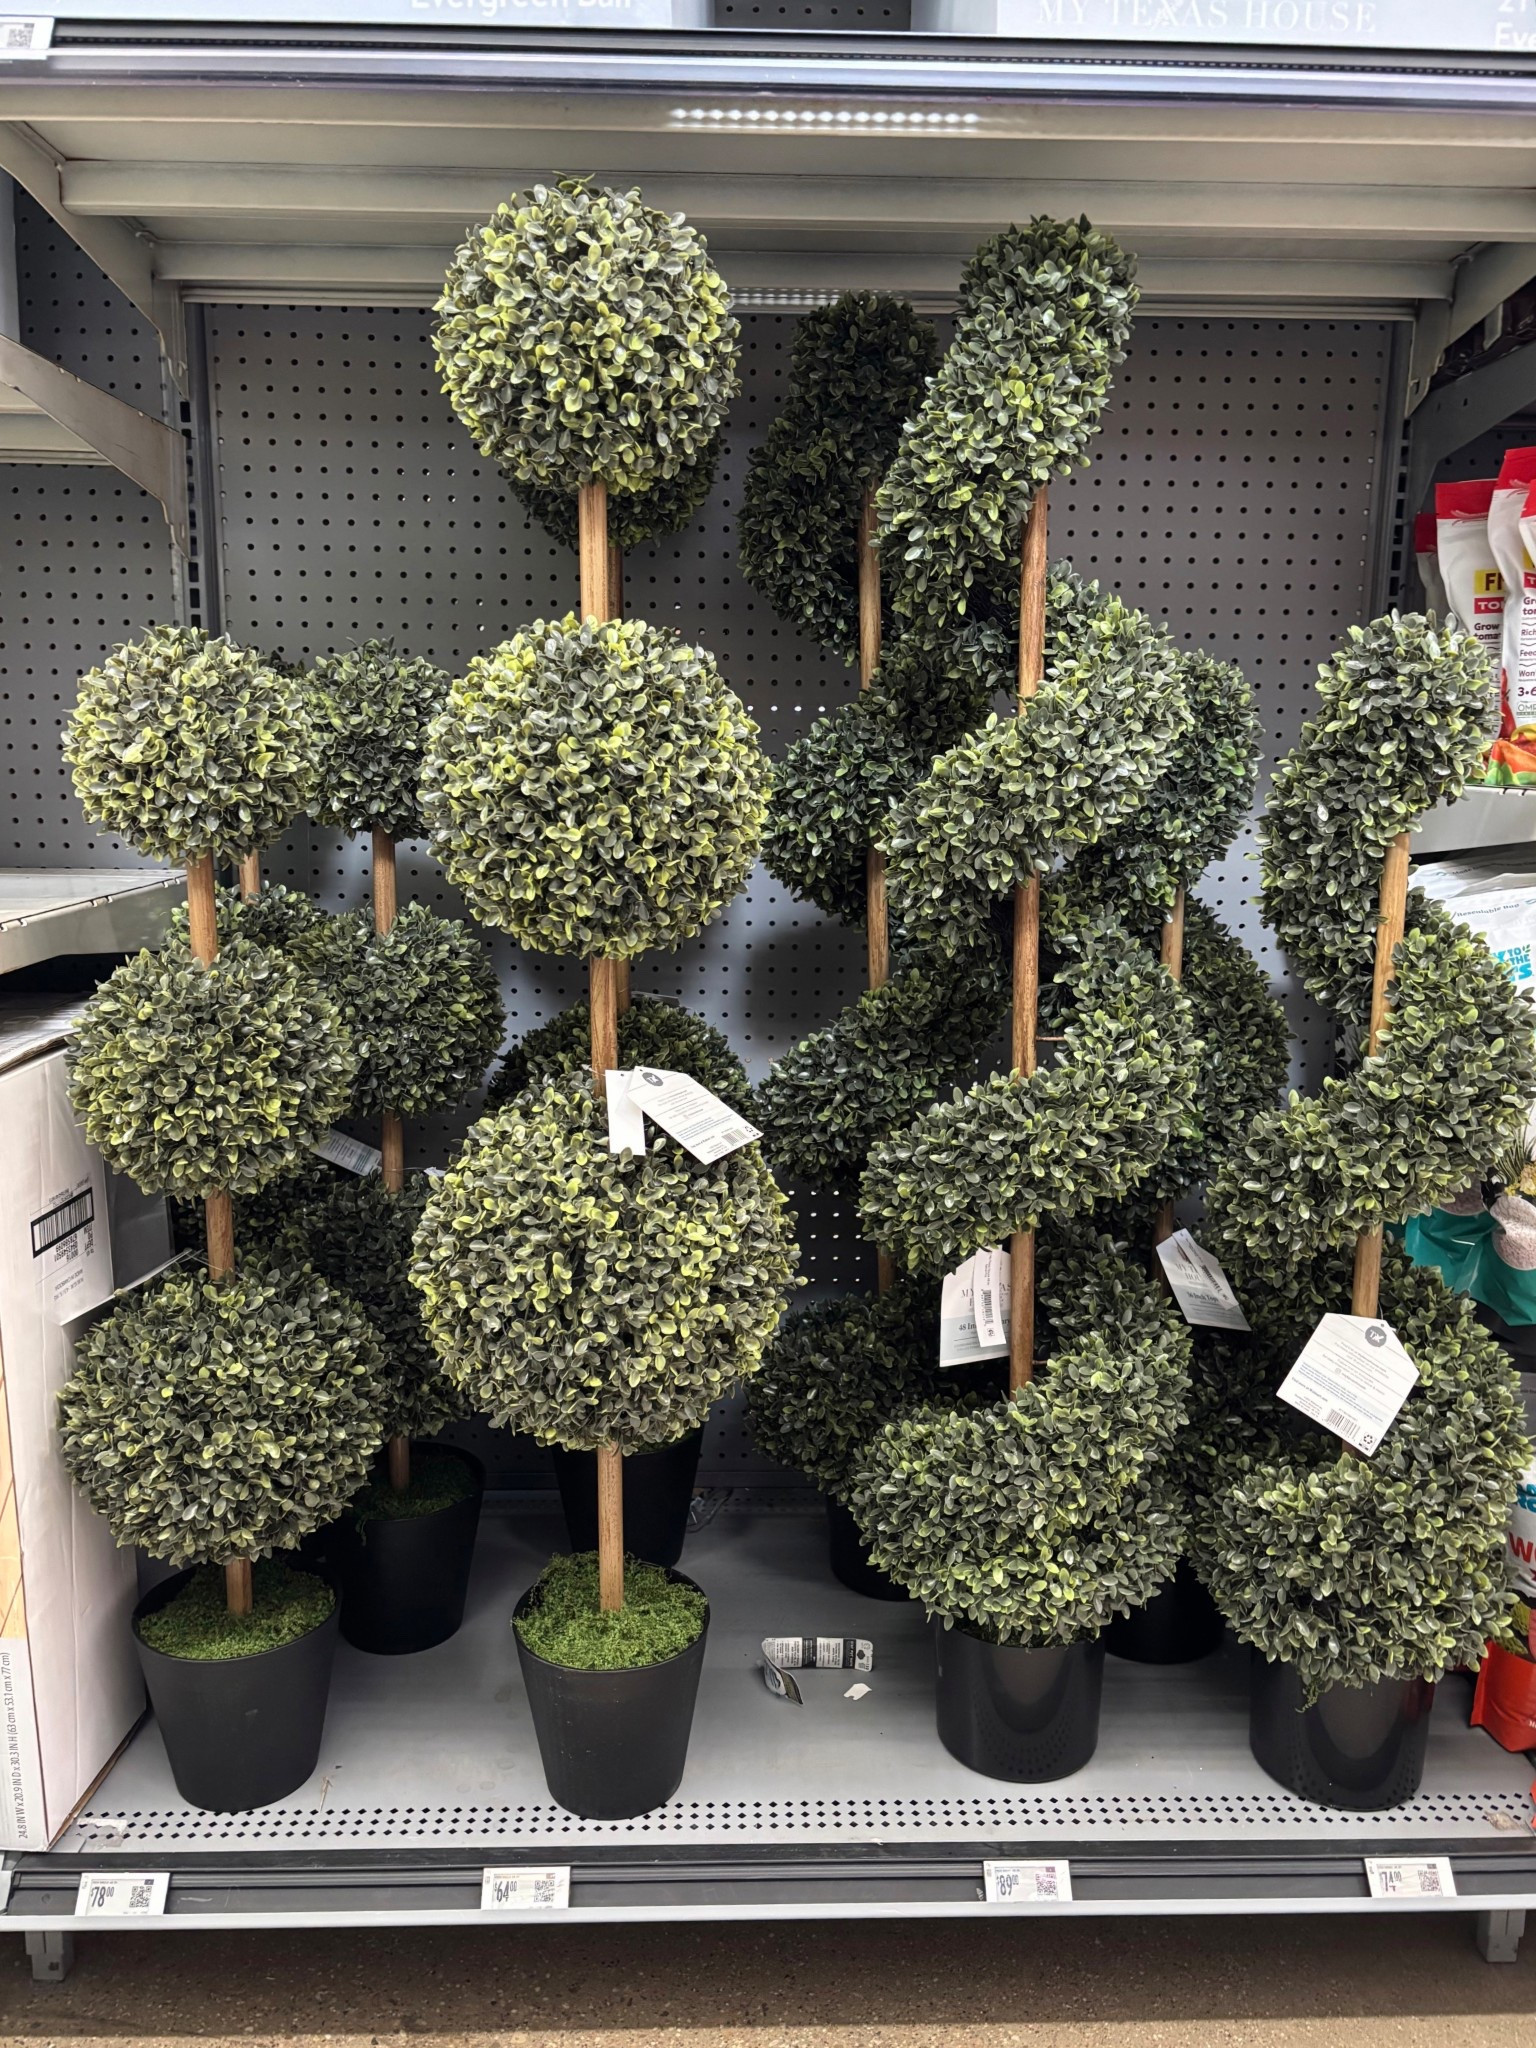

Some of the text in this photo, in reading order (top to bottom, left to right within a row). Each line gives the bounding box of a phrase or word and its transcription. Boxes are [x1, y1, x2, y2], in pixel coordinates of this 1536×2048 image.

[1036, 0, 1376, 33] MY TEXAS HOUSE
[1509, 954, 1531, 965] THE
[0, 1652, 10, 1666] cm)
[1, 1667, 11, 1675] 77
[5, 1681, 13, 1691] cm
[4, 1693, 14, 1706] 53.1
[8, 1712, 16, 1723] cm
[7, 1723, 18, 1735] (63
[9, 1743, 18, 1751] IN
[9, 1751, 20, 1766] 30.3
[12, 1778, 22, 1786] IN
[13, 1787, 24, 1802] 20.9
[15, 1807, 25, 1815] W
[16, 1816, 26, 1824] IN
[17, 1824, 28, 1840] 24.8
